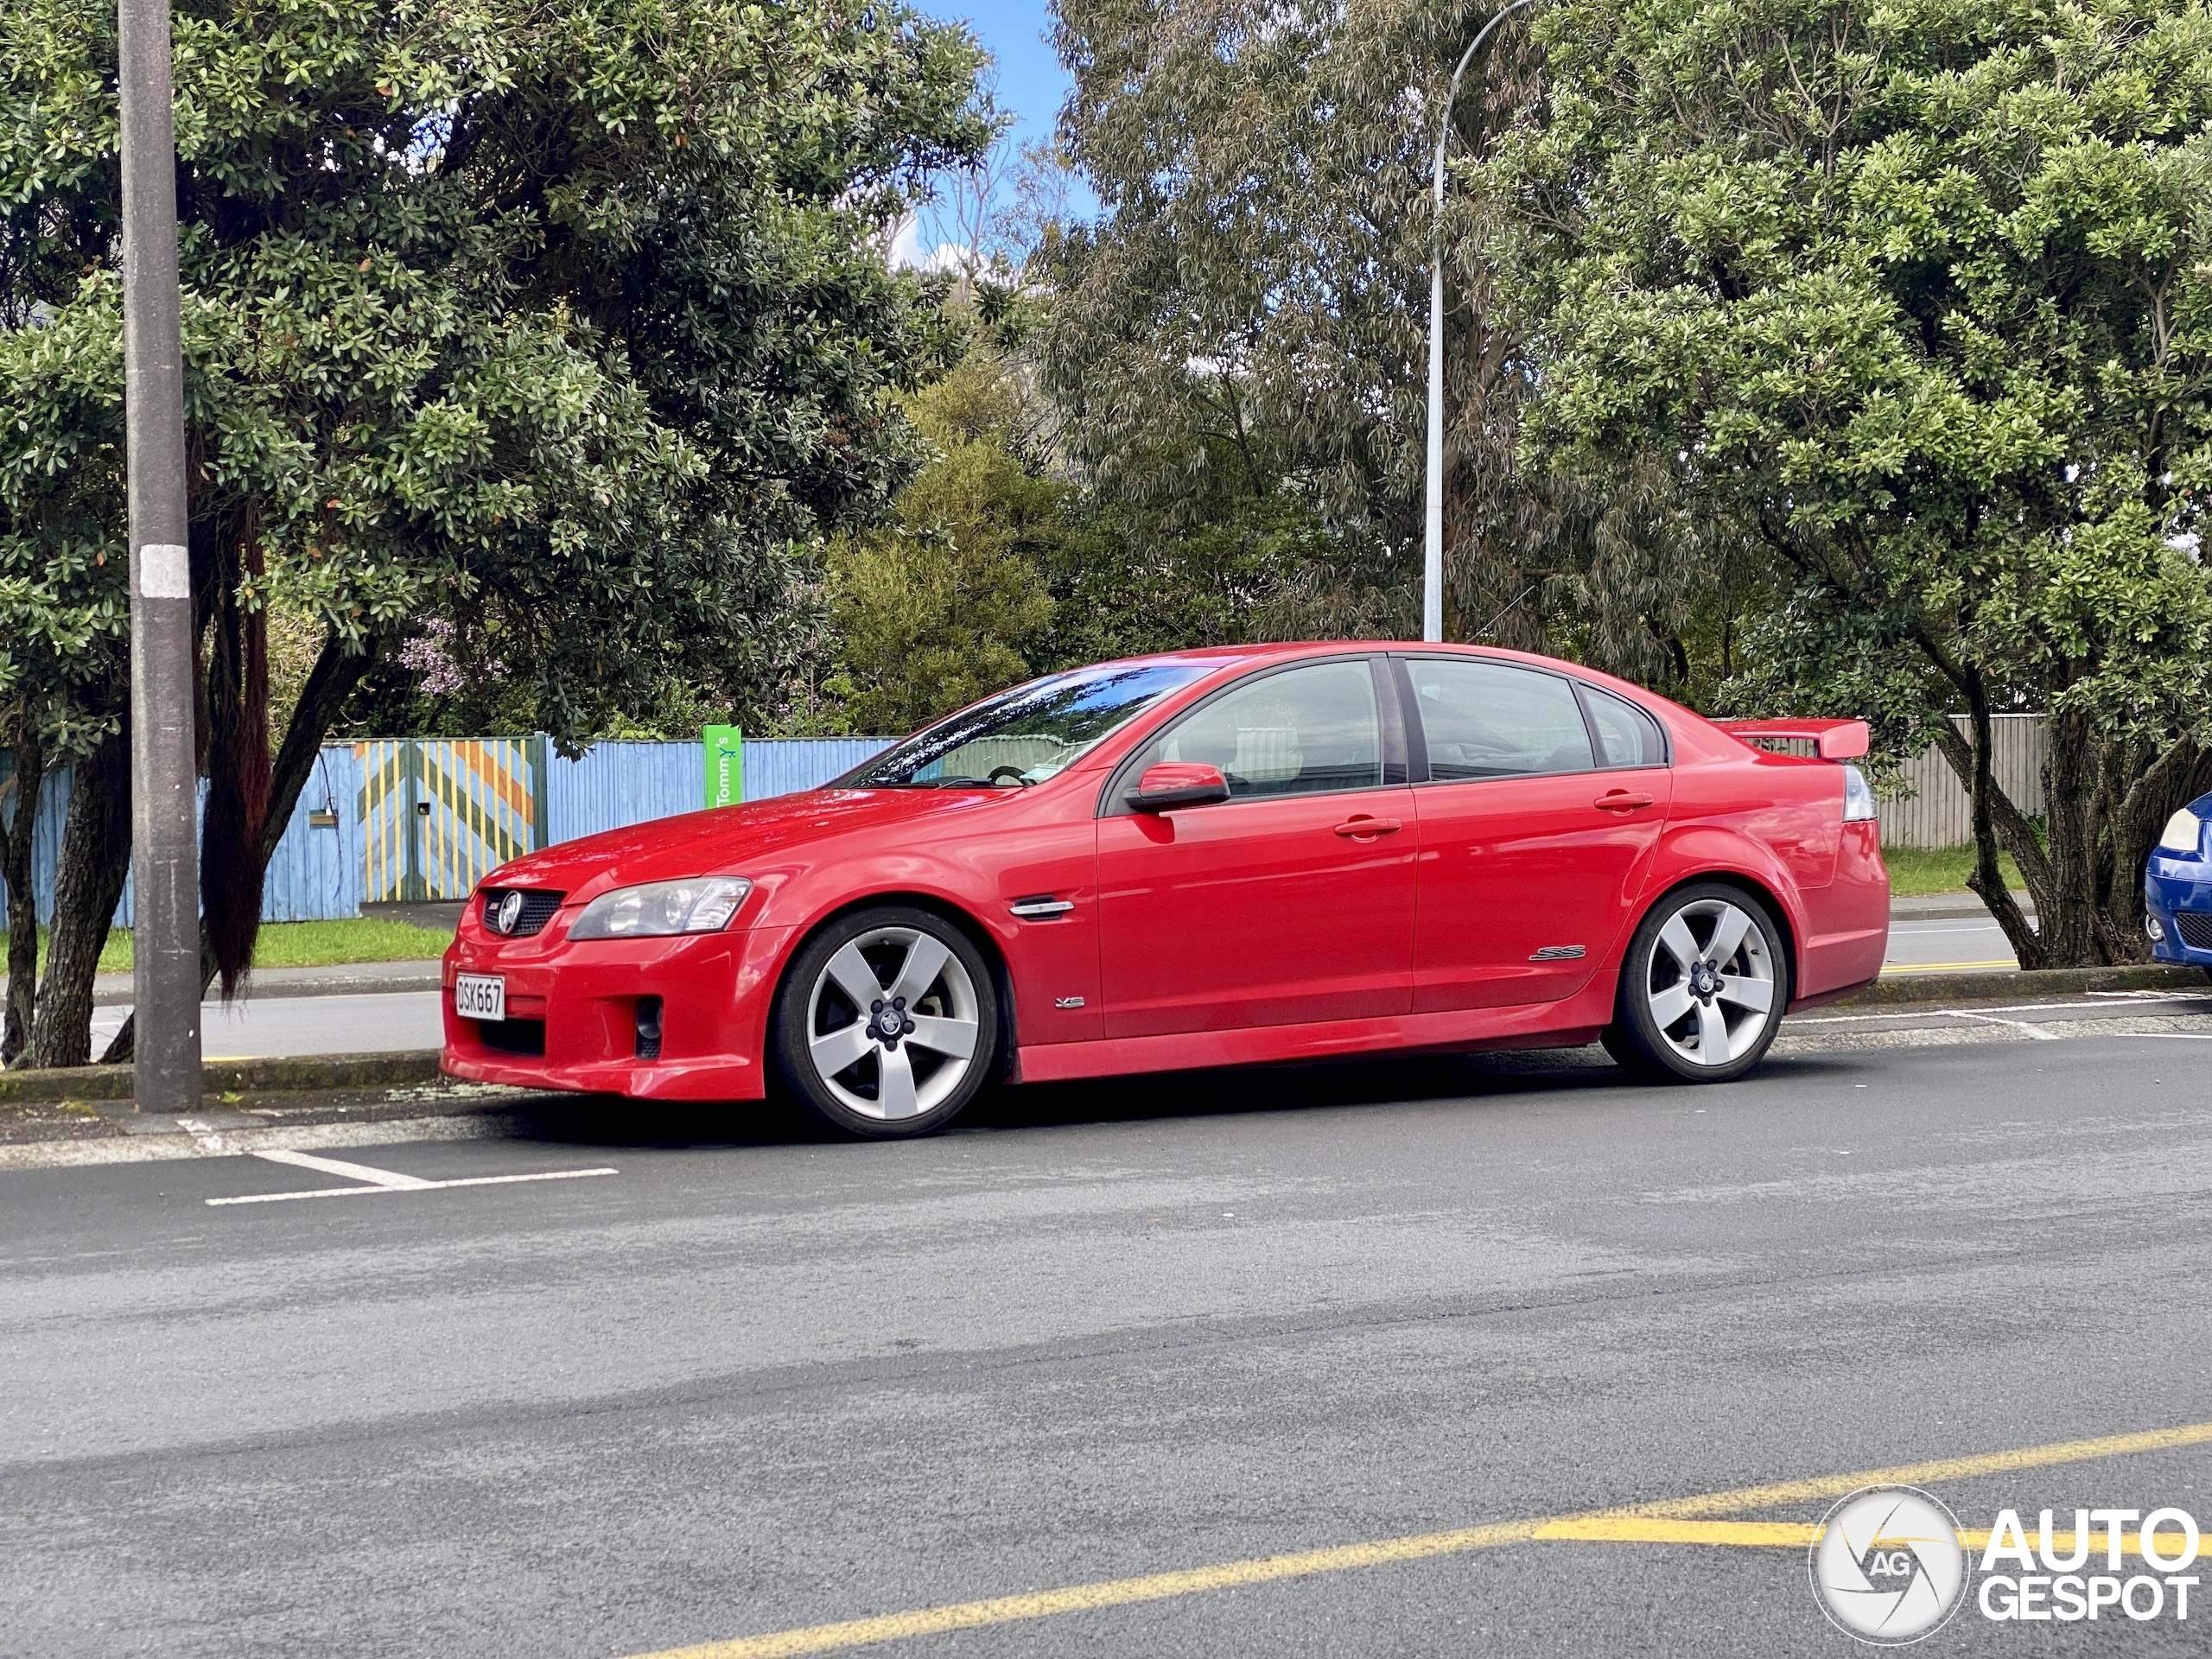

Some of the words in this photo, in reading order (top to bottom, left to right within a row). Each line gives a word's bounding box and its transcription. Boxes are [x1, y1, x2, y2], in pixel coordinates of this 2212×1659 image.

[715, 736, 736, 808] Tommy's
[1529, 944, 1586, 961] SS
[458, 981, 501, 1014] DSK667
